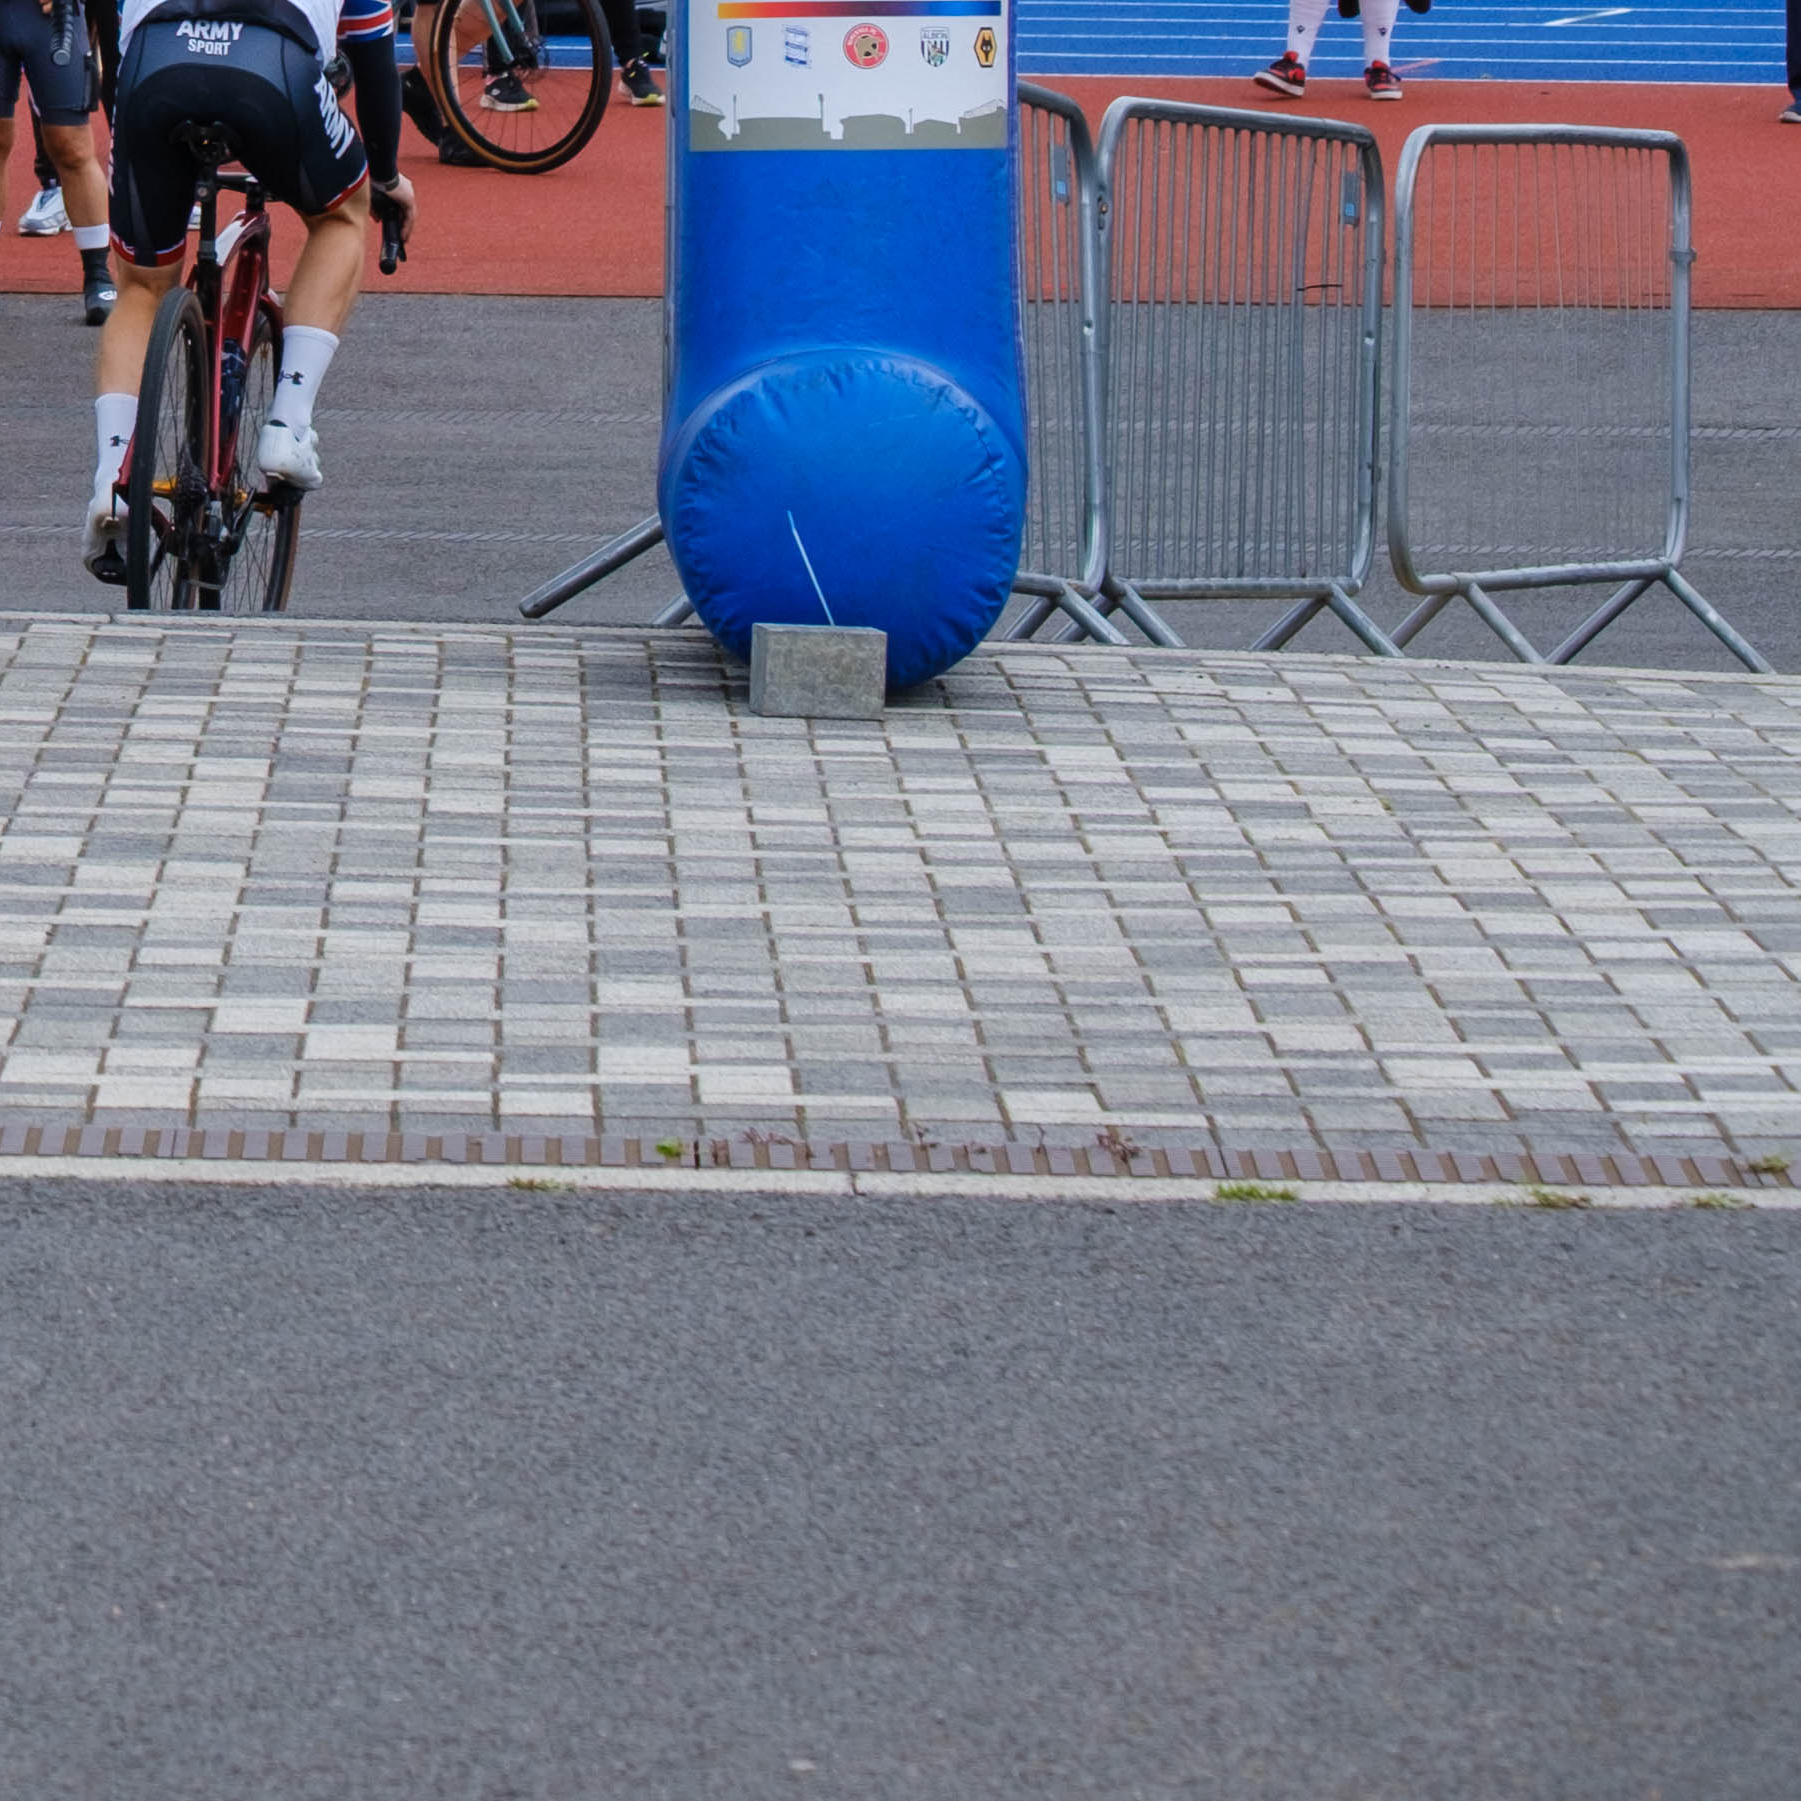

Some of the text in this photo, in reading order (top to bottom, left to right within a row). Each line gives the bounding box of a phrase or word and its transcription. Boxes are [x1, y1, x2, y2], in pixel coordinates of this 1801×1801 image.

[176, 20, 244, 41] ARMY
[187, 38, 231, 56] SPORT
[313, 72, 355, 160] ARMY
